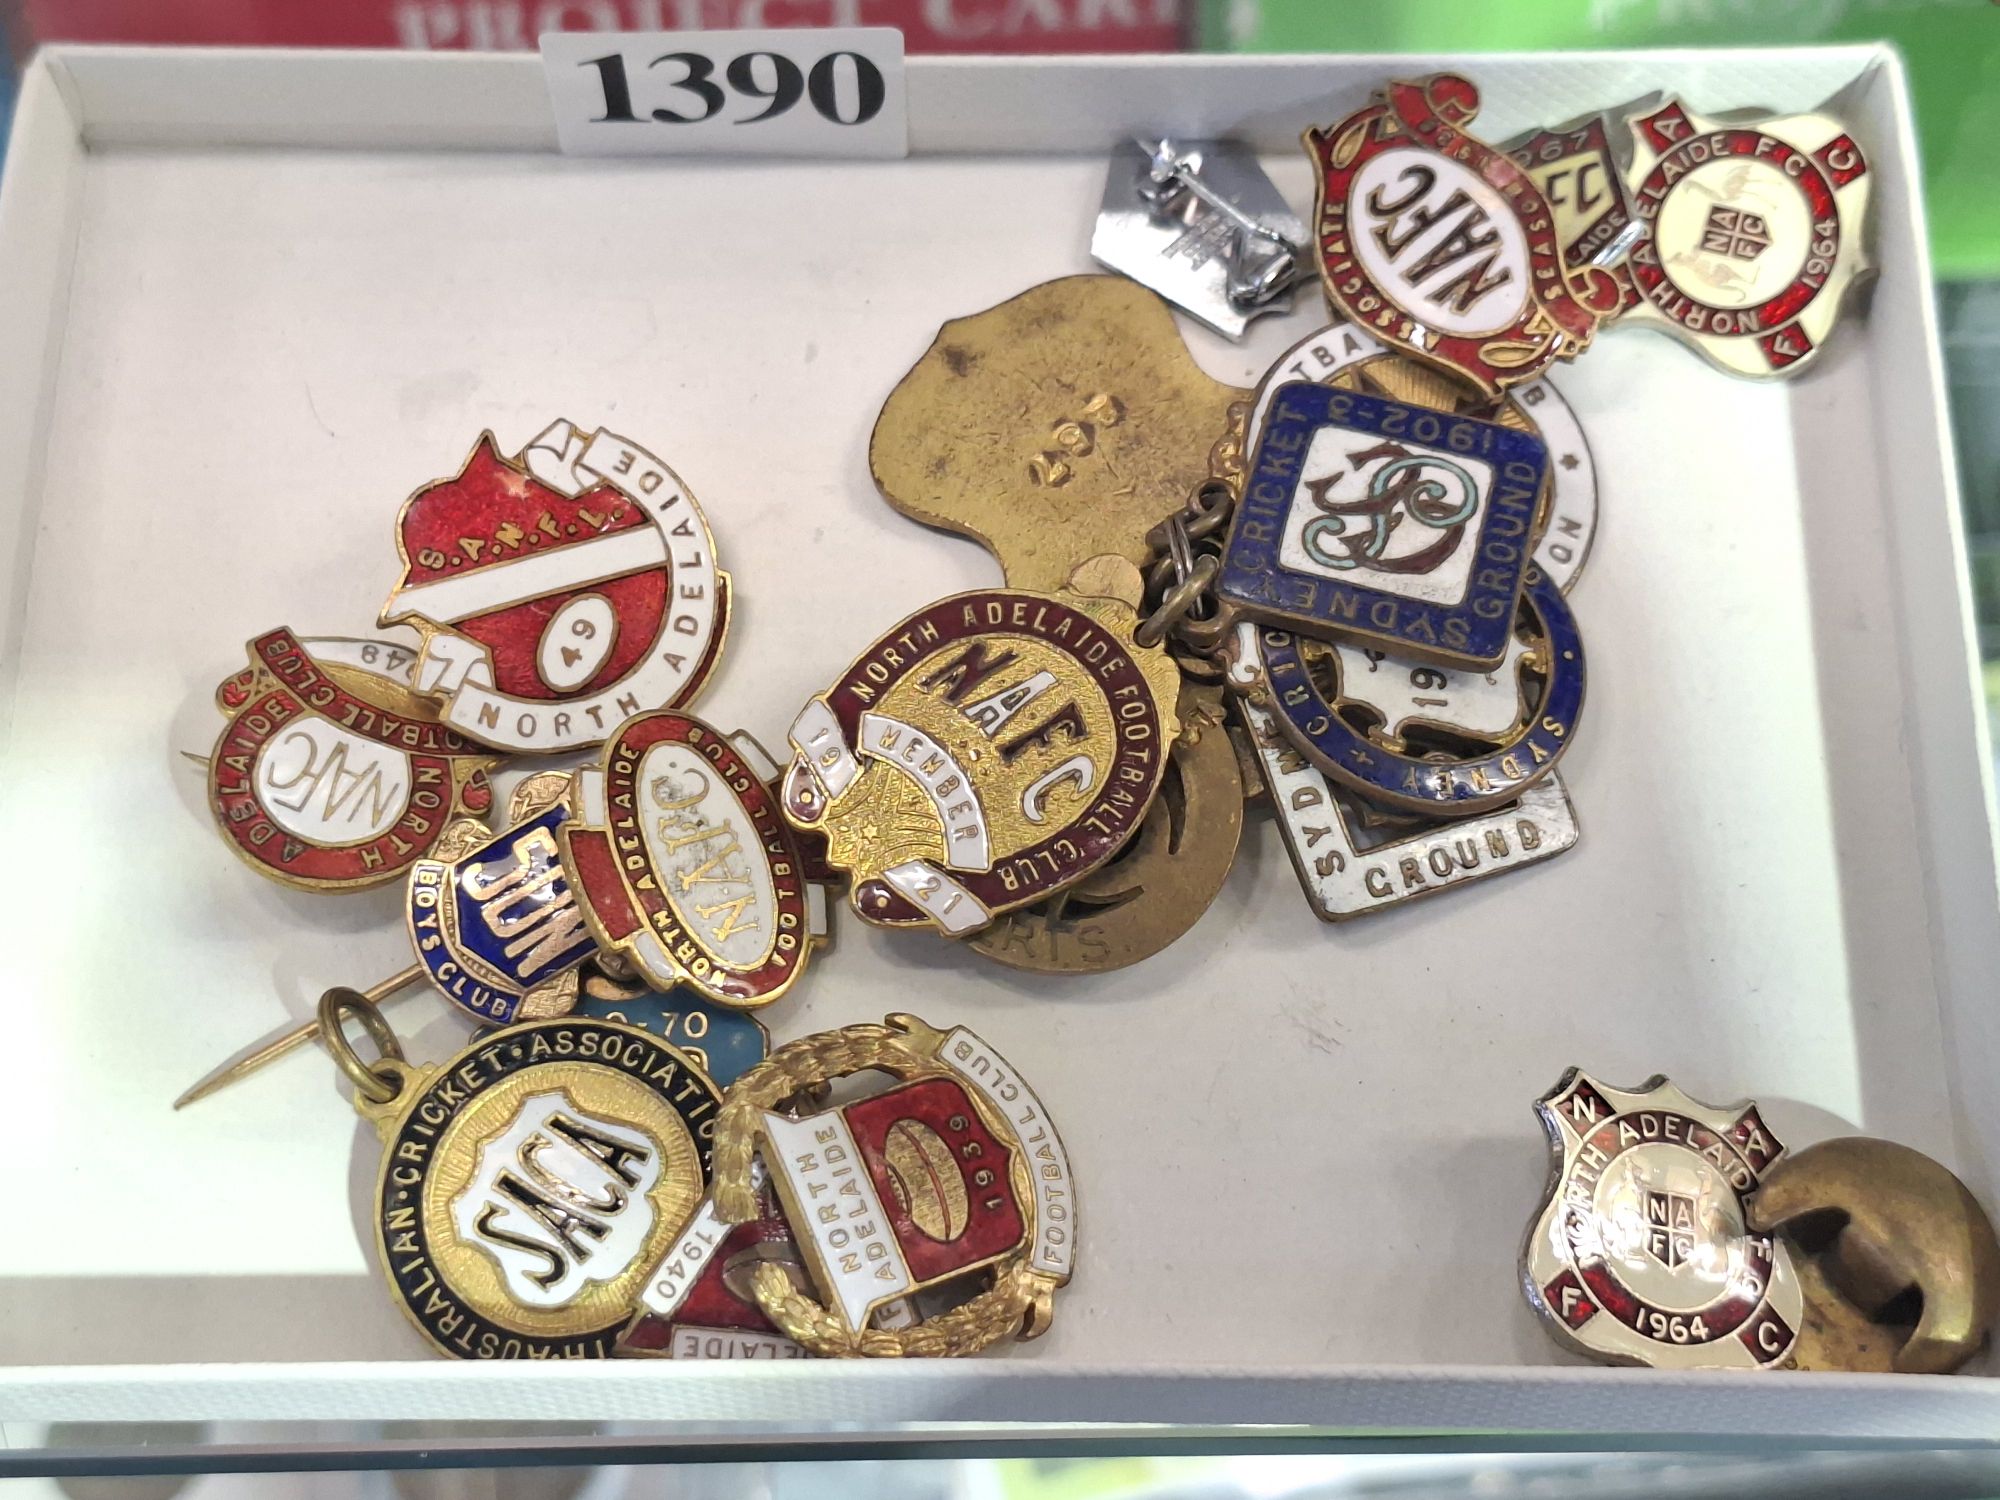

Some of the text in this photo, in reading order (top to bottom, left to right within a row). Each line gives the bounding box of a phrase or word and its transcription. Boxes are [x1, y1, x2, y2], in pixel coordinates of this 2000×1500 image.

[578, 50, 886, 126] 1390
[1363, 163, 1514, 317] NAFC
[1802, 217, 1837, 288] 1964
[1648, 287, 1761, 334] NORTH
[1233, 401, 1537, 648] SYDNEY CRICKET GROUND
[477, 449, 706, 738] NORTH ADELAIDE
[266, 638, 335, 707] CLUB
[220, 696, 443, 871] NORTH ADELAIDE
[849, 601, 1153, 892] NORTH ADELAIDE FOOTBALL CLUB
[877, 723, 978, 845] MEMBER
[1402, 715, 1567, 797] SYDNEY
[613, 743, 658, 891] ADELAIDE
[1365, 818, 1542, 899] GROUND
[416, 867, 511, 1020] BOYS CLUB
[652, 909, 729, 989] NORTH
[753, 807, 802, 969] FOOTBALL
[393, 1046, 503, 1184] CRICKET
[531, 1030, 715, 1139] ASSOCIATIO
[946, 1112, 1004, 1212] 1939
[953, 1038, 1069, 1265] FOOTBALL CLUB
[1618, 1115, 1752, 1196] ADELAID
[472, 1108, 651, 1292] SACA
[655, 1219, 715, 1300] 1940
[796, 1152, 864, 1275] NORTH
[815, 1124, 899, 1283] ADELAIDE
[1635, 1308, 1710, 1342] 1964
